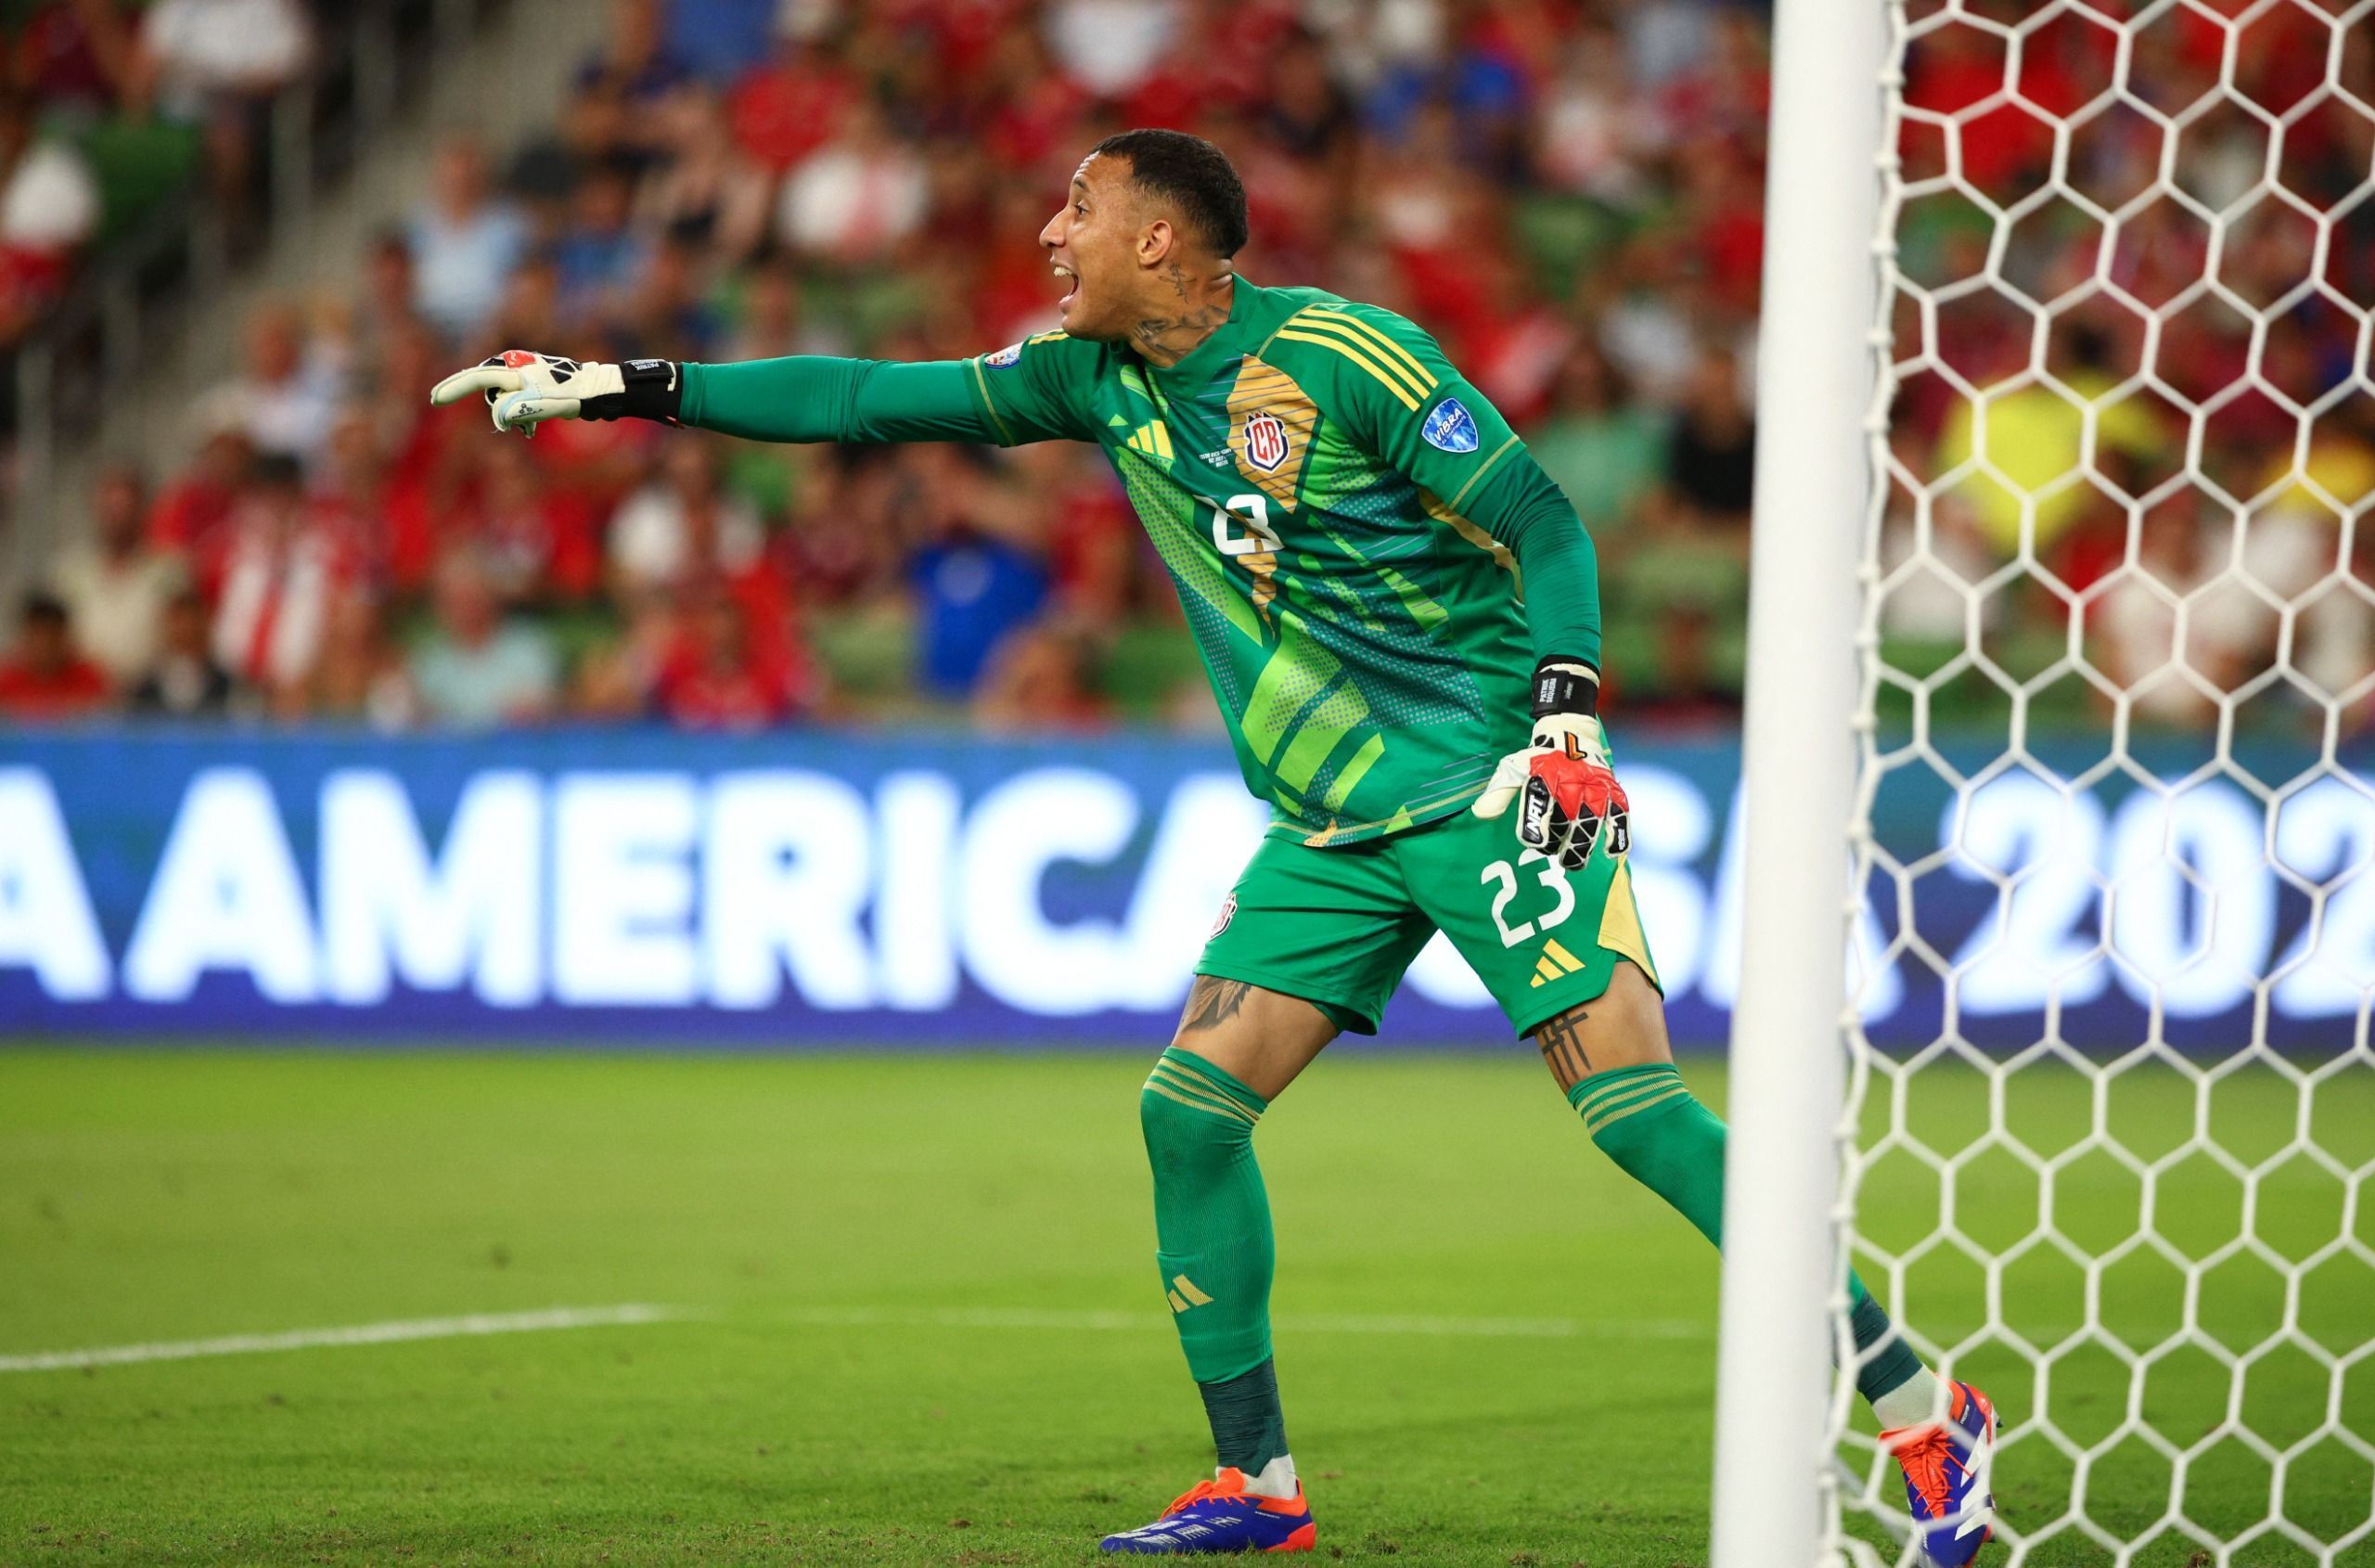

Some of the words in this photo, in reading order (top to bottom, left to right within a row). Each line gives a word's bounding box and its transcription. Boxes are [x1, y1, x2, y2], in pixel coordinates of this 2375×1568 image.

[1252, 420, 1280, 461] CR
[1434, 407, 1464, 442] VIBRA
[123, 765, 1273, 1015] AMERICA
[1481, 848, 1575, 949] 23
